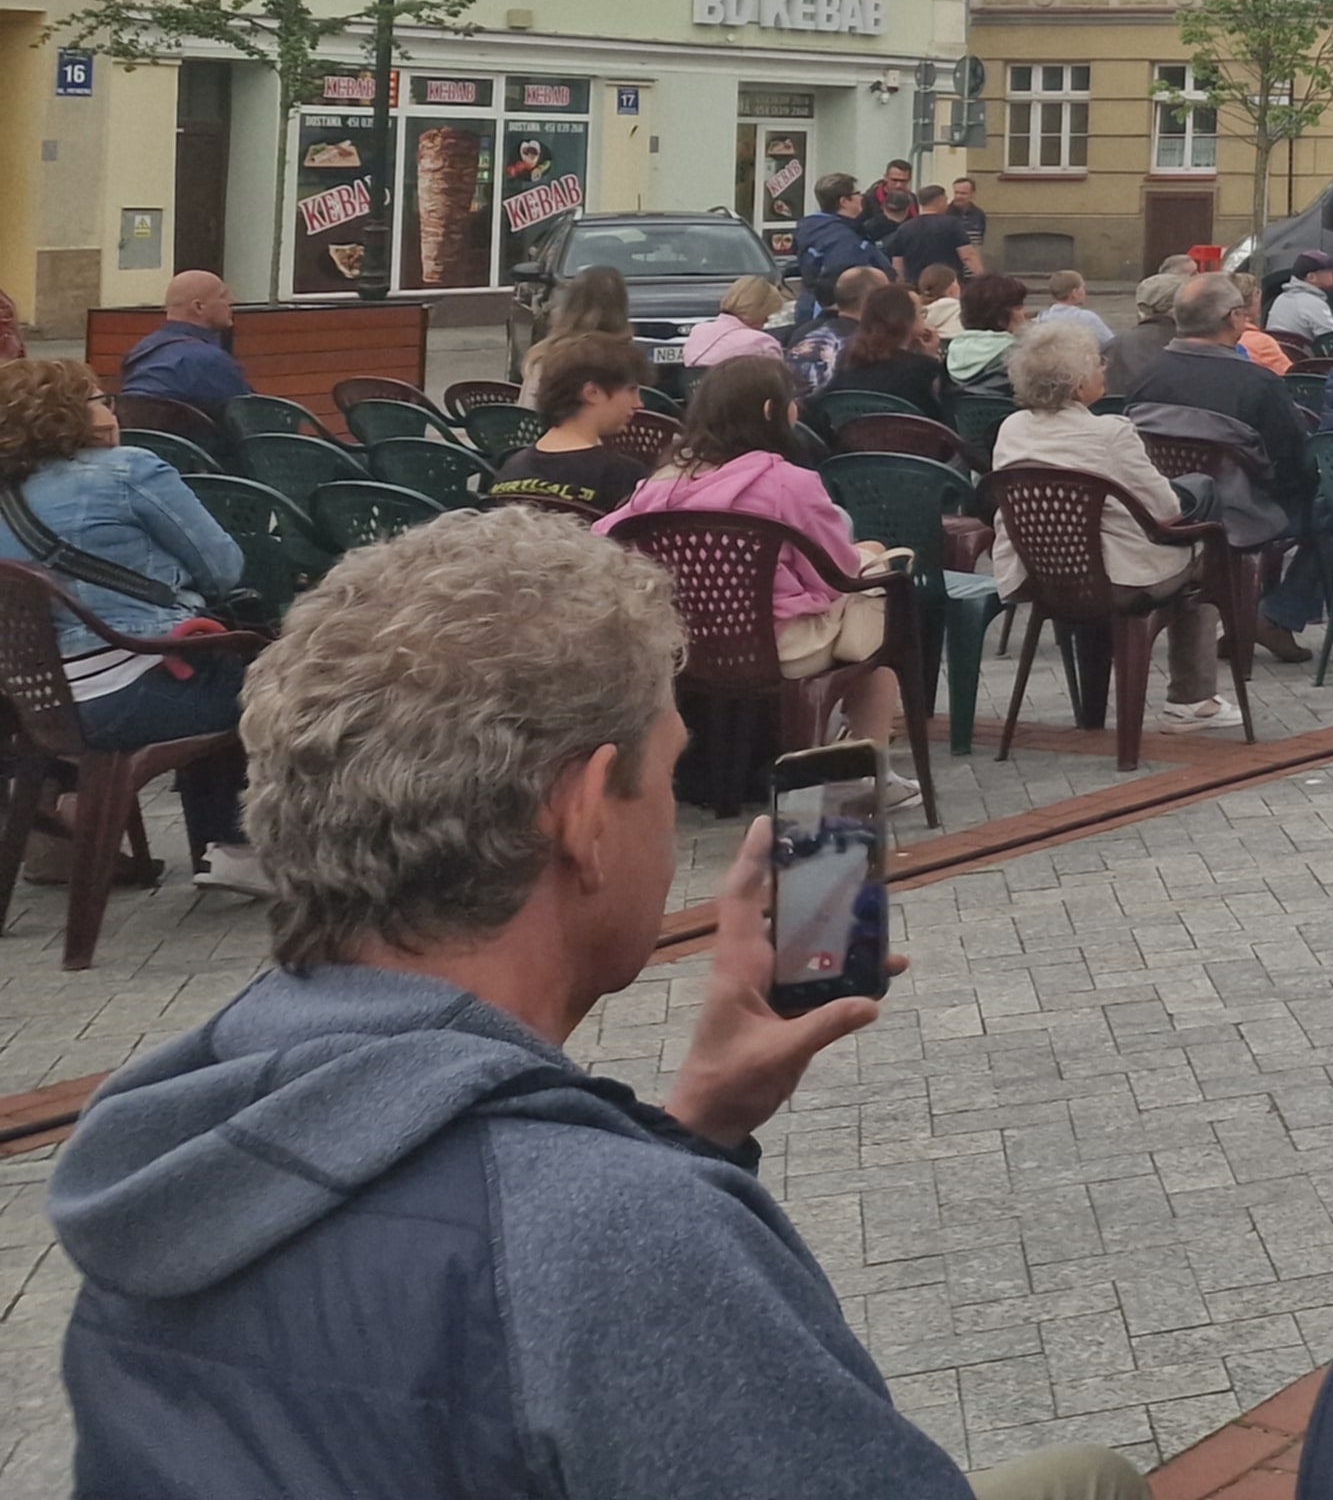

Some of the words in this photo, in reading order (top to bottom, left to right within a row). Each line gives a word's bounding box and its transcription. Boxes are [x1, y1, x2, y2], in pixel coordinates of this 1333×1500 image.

[63, 64, 86, 83] 16
[323, 76, 376, 99] KEBAB
[426, 81, 476, 102] KEBAB
[523, 85, 570, 106] KEBAB
[621, 95, 635, 106] 17
[766, 159, 803, 198] KEBAB
[298, 175, 391, 236] KEBA
[503, 174, 583, 232] KEBAB
